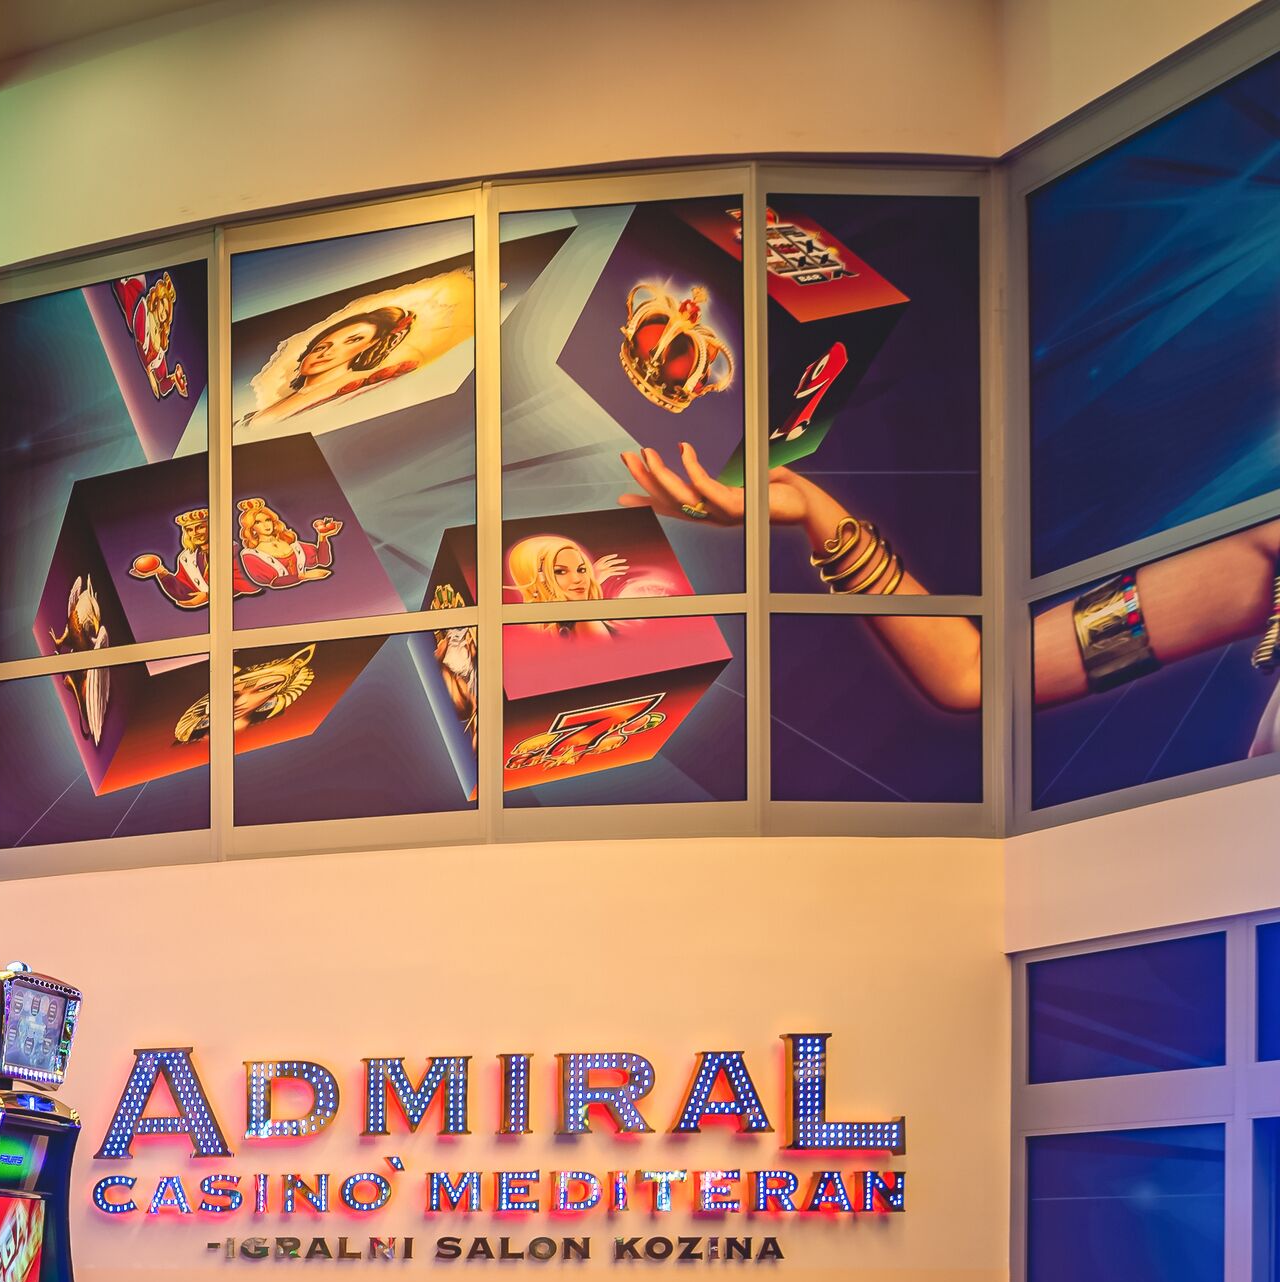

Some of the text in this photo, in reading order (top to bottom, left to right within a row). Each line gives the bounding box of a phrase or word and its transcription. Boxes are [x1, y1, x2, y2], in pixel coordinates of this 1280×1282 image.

[93, 1033, 906, 1159] ADMIRAL
[425, 1168, 907, 1215] MEDITERAN
[434, 1235, 592, 1262] SALON
[613, 1235, 786, 1262] KOZINA
